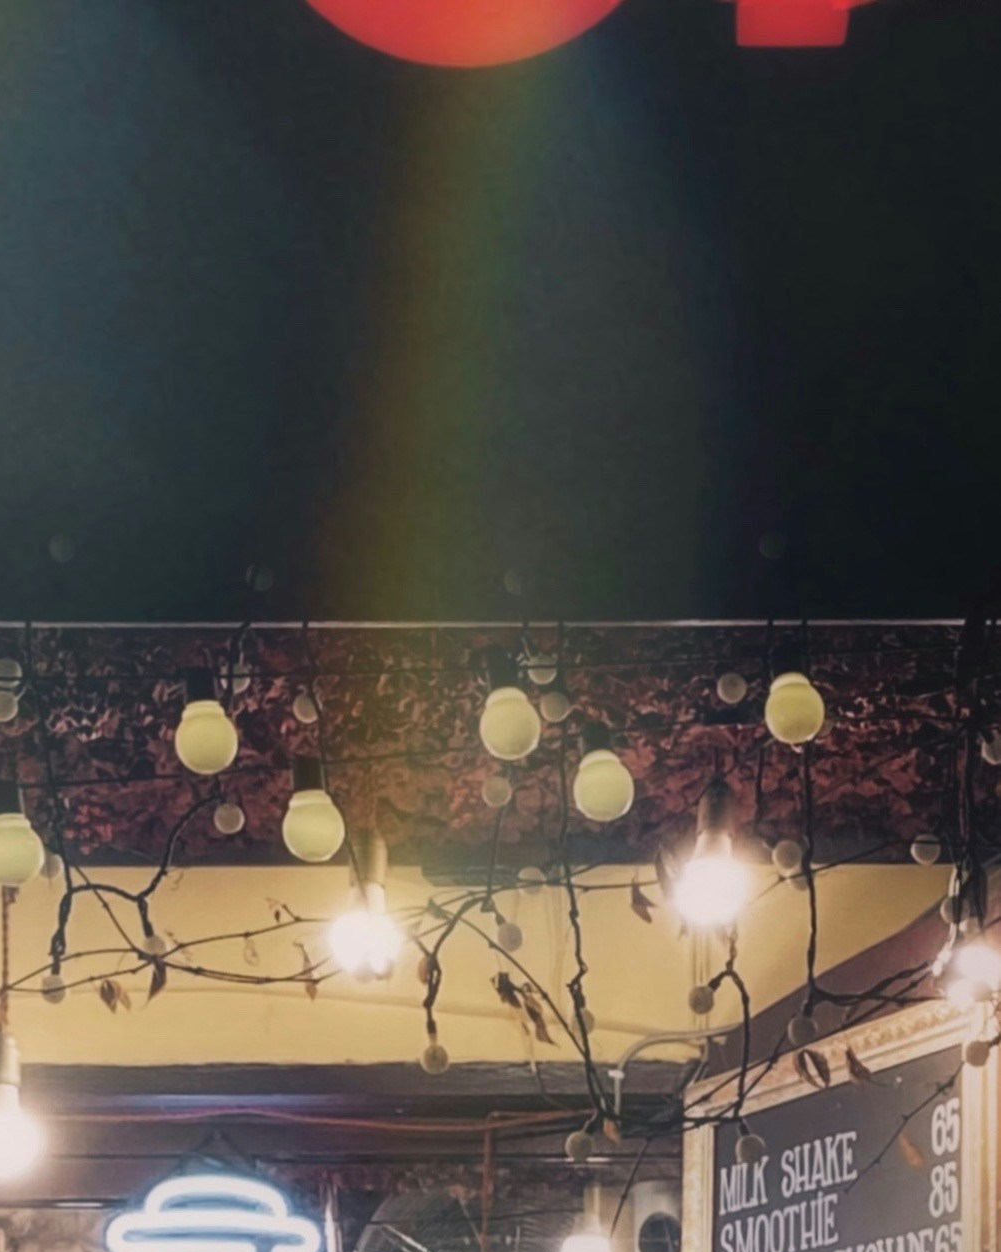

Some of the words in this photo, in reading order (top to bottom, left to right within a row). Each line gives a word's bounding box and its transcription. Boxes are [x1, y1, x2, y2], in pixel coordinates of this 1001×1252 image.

[781, 1131, 858, 1198] SHAKE
[931, 1098, 960, 1156] 65
[929, 1161, 958, 1218] 85
